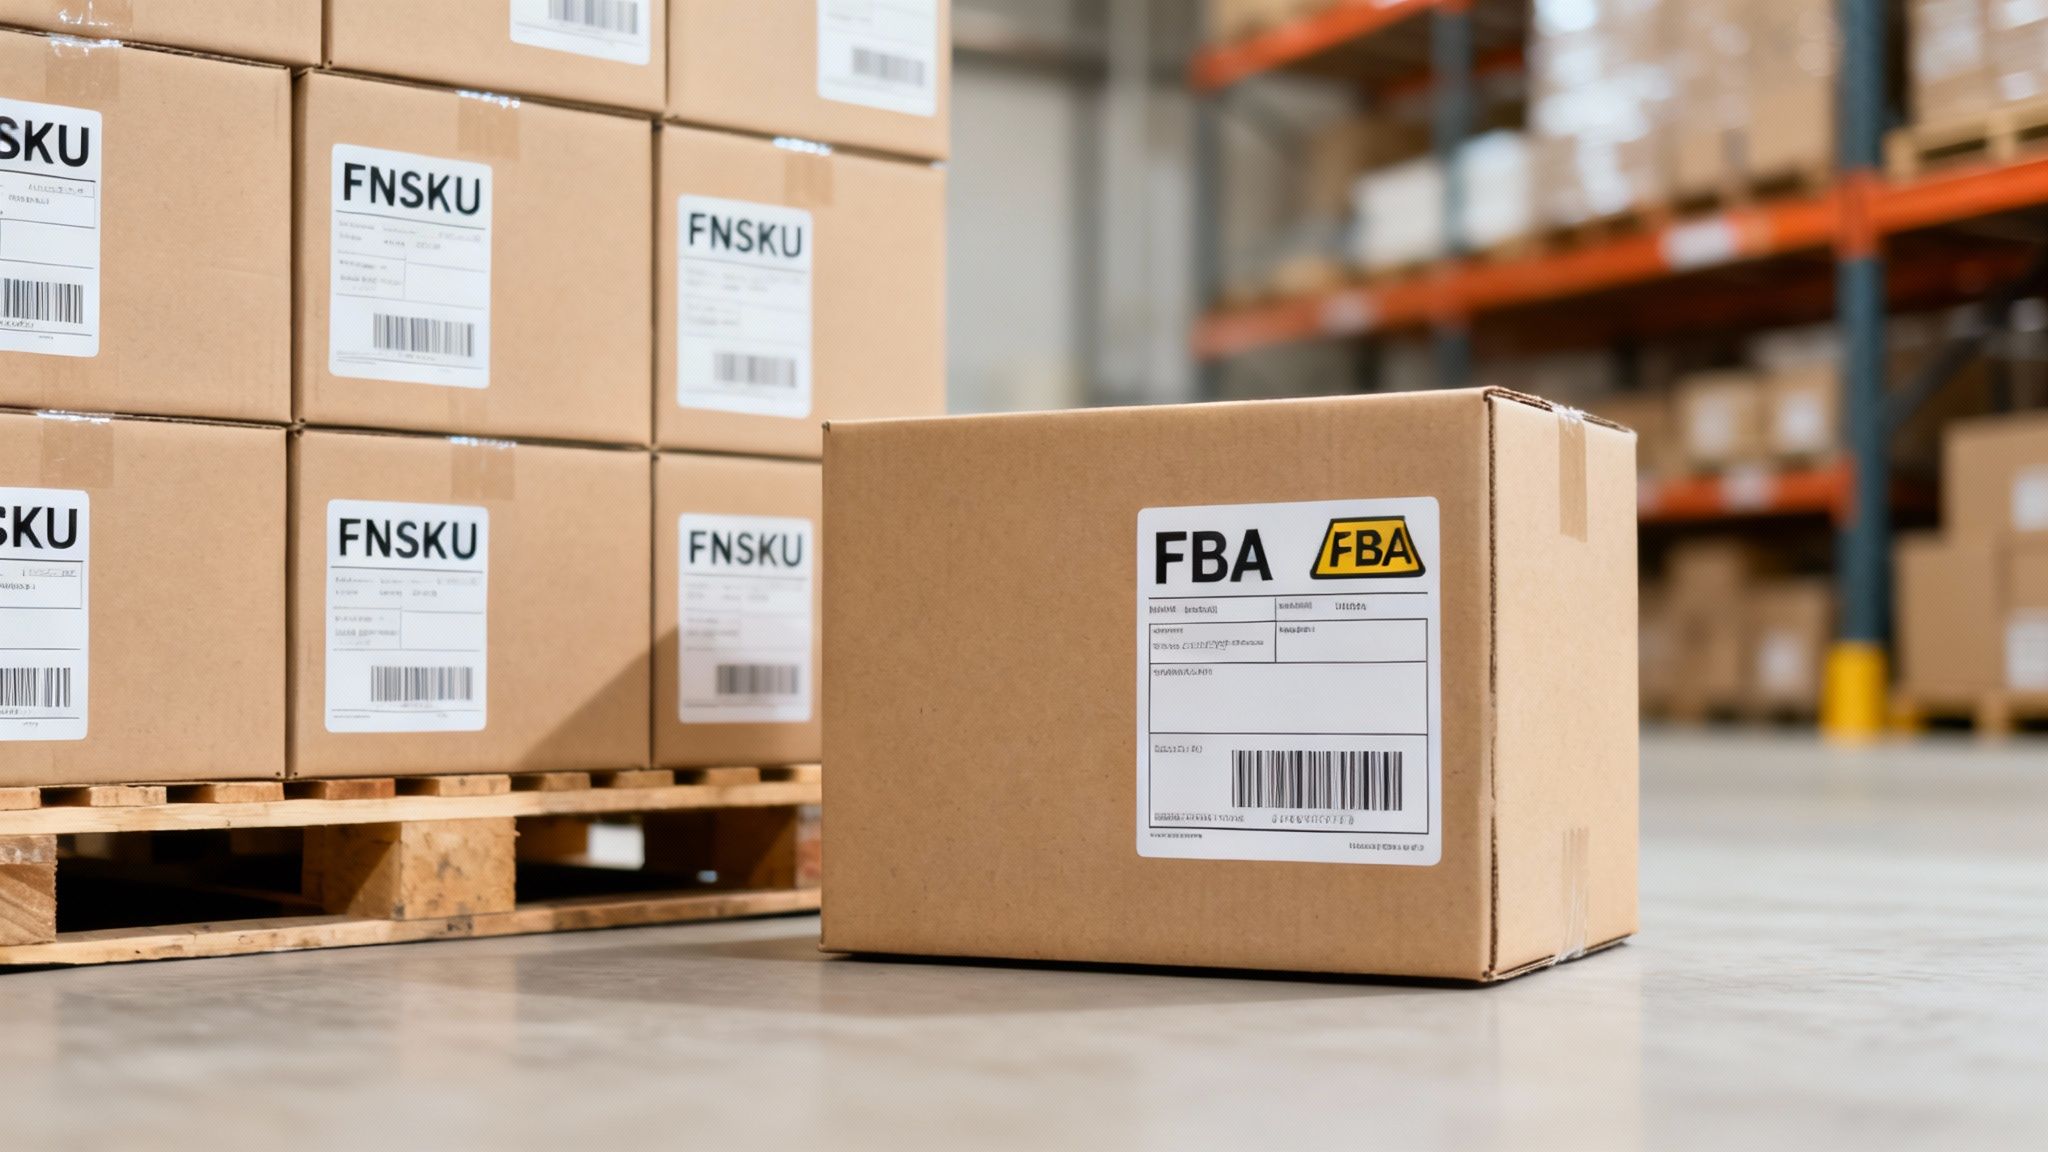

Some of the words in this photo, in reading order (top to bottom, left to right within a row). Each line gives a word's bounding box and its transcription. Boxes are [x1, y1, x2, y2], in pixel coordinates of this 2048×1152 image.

[343, 162, 482, 215] FNSKU
[689, 212, 803, 259] FNSKU
[0, 505, 78, 550] KU
[339, 517, 478, 560] FNSKU
[689, 530, 803, 568] FNSKU
[1329, 527, 1413, 568] FBA
[1155, 528, 1274, 585] FBA
